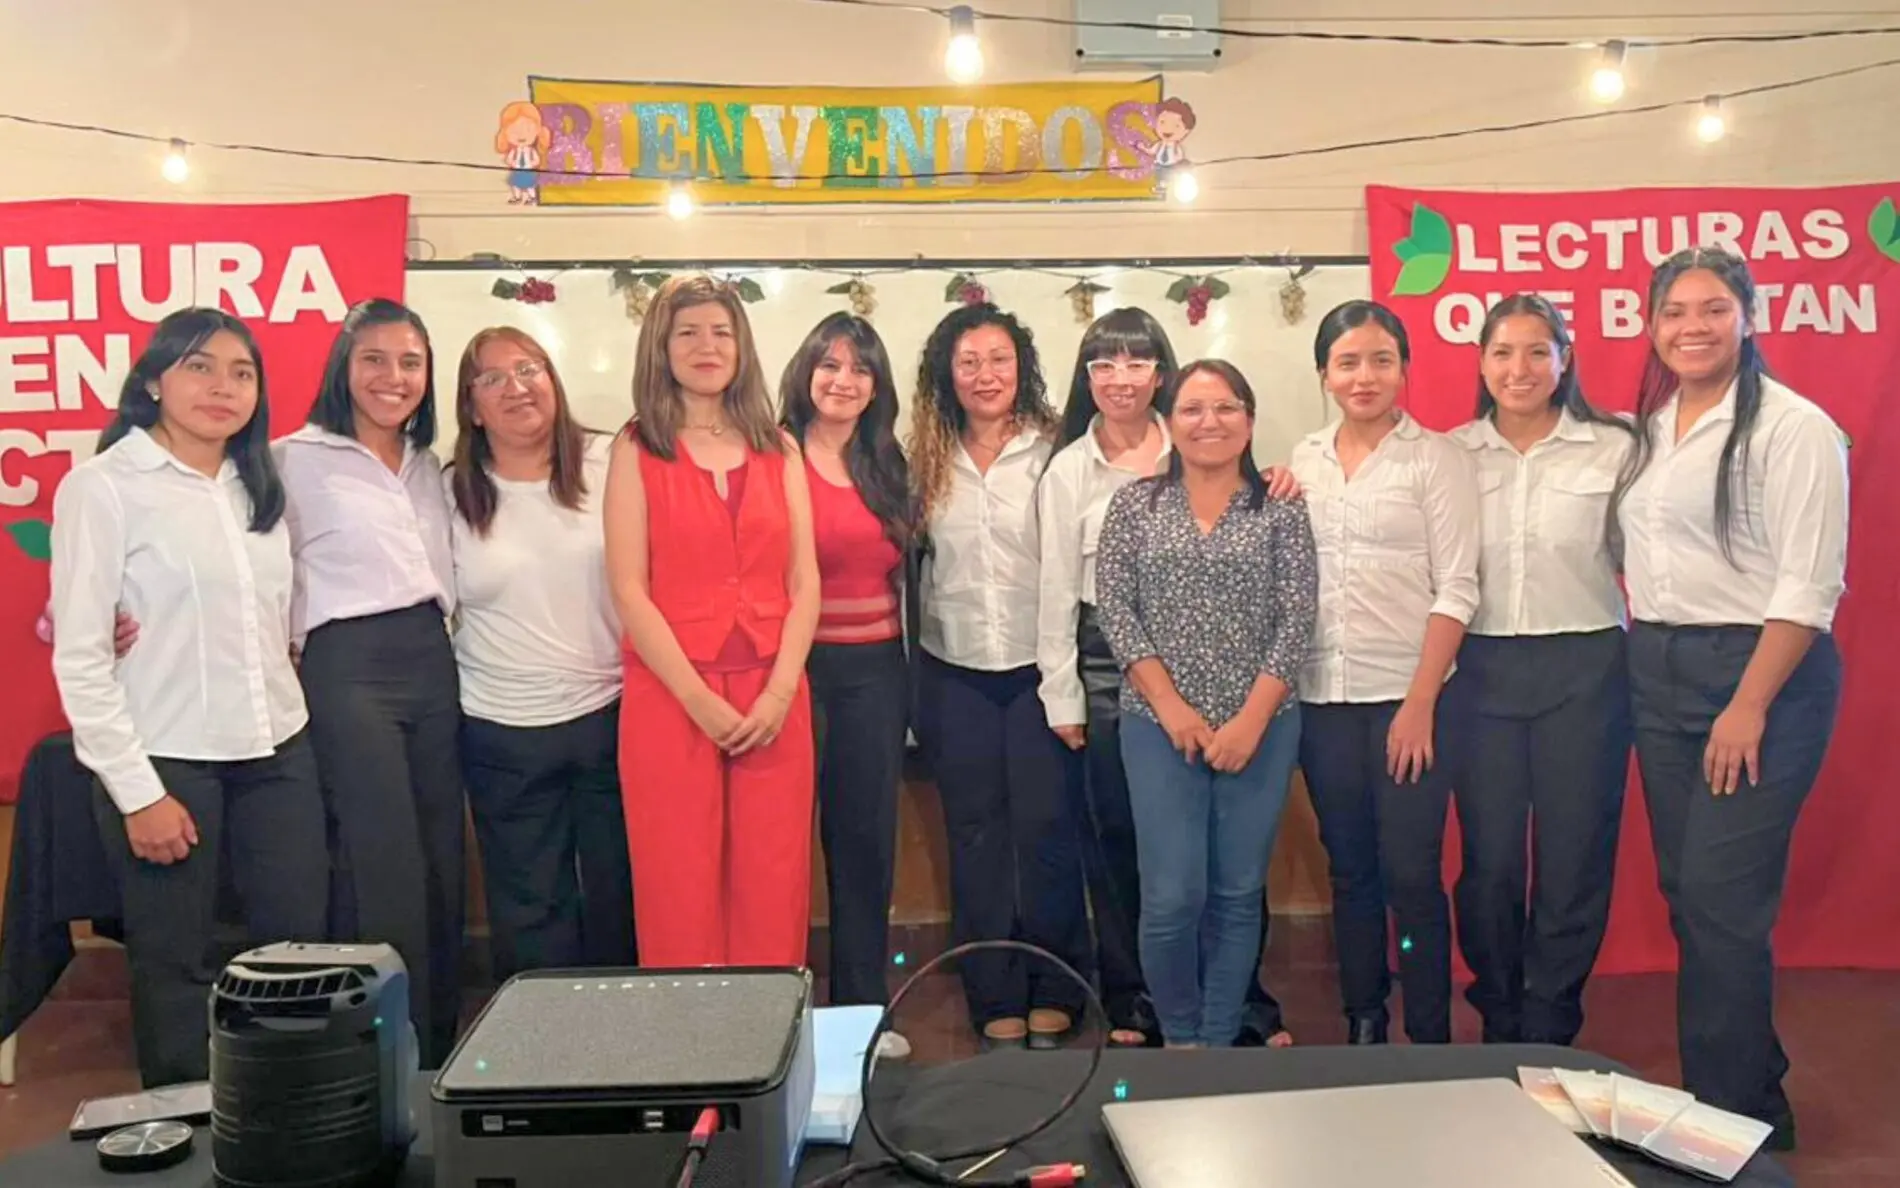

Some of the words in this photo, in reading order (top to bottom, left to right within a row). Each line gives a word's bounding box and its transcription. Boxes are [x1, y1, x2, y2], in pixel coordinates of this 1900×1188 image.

[538, 101, 1159, 188] BIENVENIDOS
[1456, 209, 1850, 271] LECTURAS
[0, 241, 348, 323] LTURA
[1433, 289, 1576, 346] QE
[1600, 283, 1878, 339] BTAN
[0, 333, 131, 413] EN
